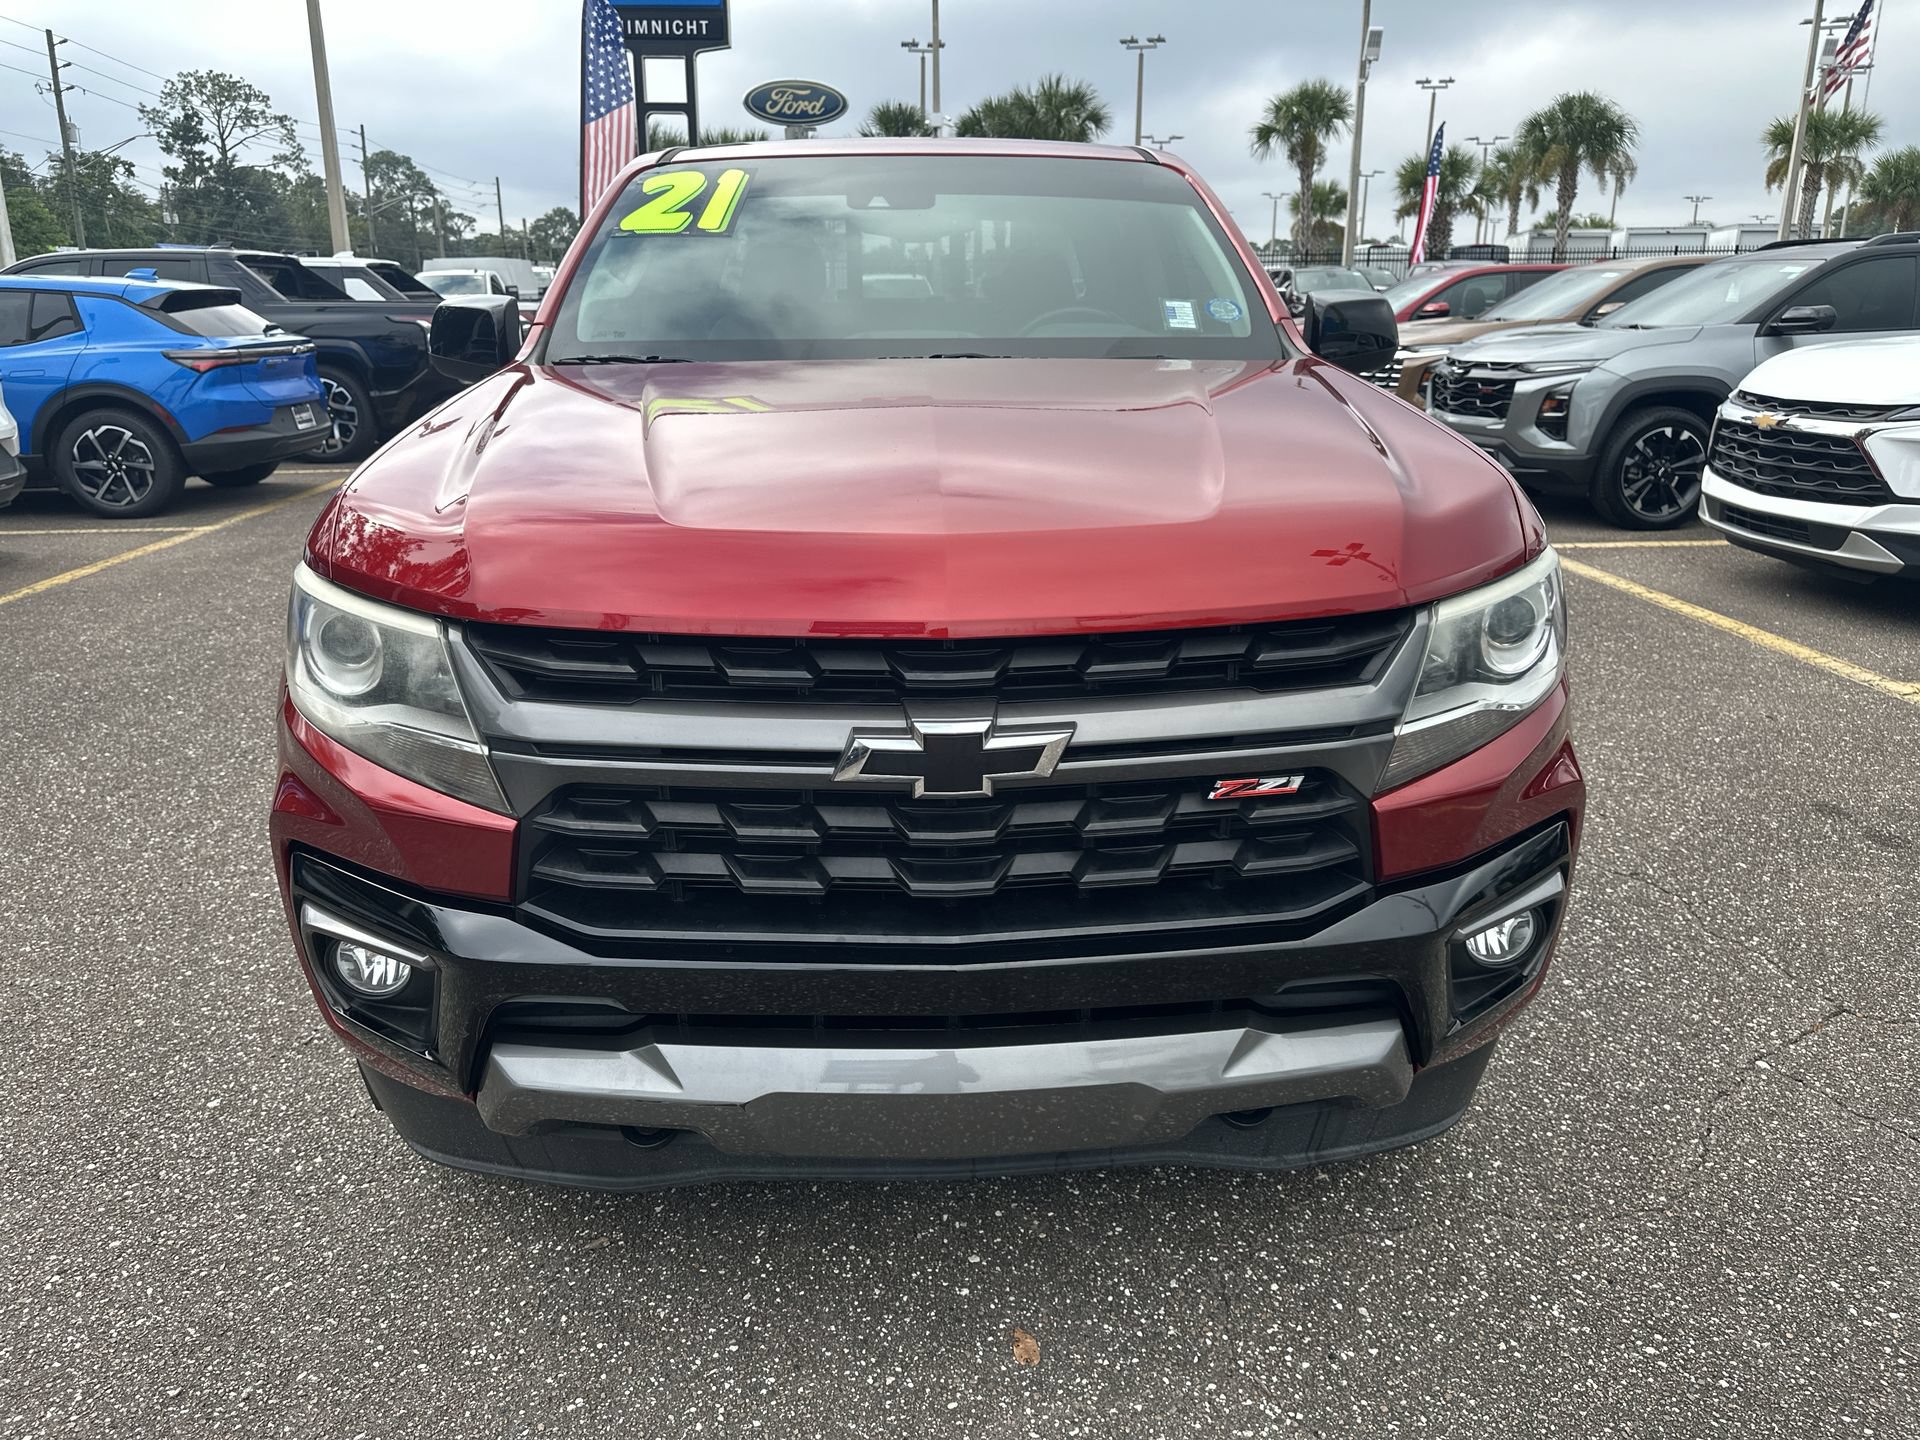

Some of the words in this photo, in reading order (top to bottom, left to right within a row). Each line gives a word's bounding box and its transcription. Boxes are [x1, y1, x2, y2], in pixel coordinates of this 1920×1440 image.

[621, 19, 709, 35] IMNICHT
[765, 87, 826, 114] Ford
[619, 168, 749, 234] 21
[1207, 775, 1305, 800] Z71
